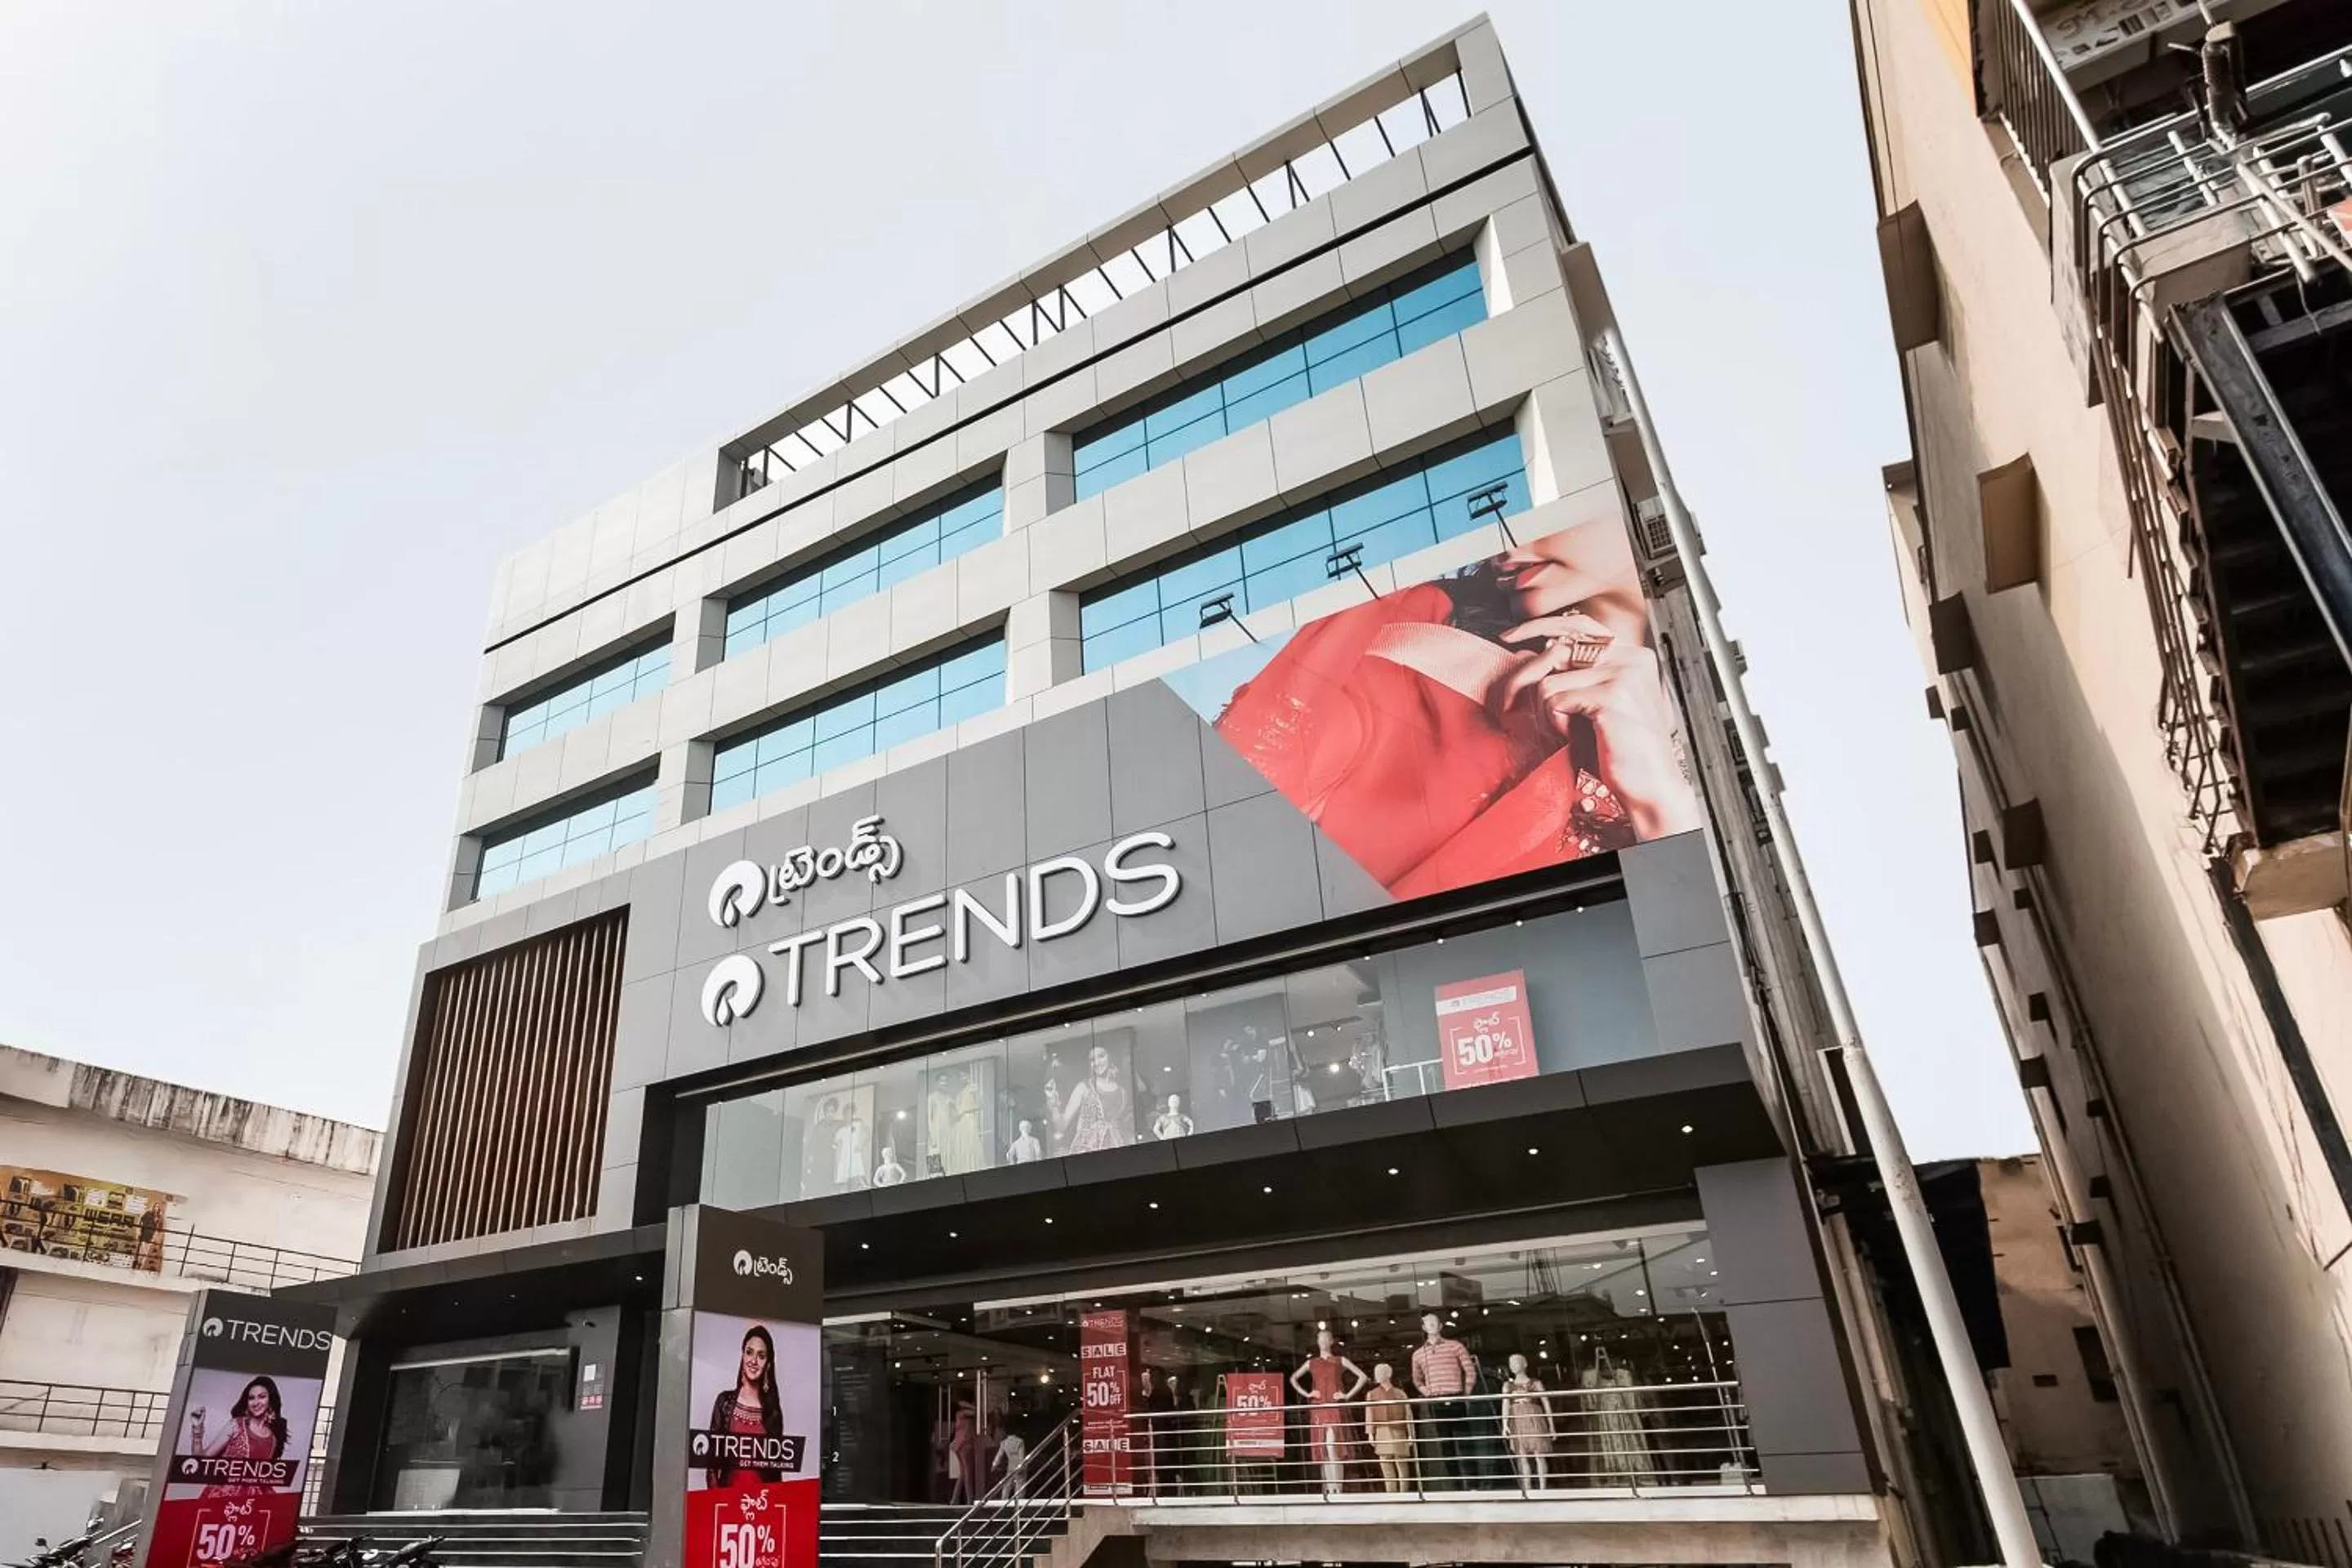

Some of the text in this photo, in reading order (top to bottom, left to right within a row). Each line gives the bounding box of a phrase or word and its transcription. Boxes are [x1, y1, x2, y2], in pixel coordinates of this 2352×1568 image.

[768, 814, 902, 905] ట్రెండ్స్
[768, 832, 1181, 1006] TRENDS
[1458, 1031, 1512, 1066] 50%
[754, 1256, 793, 1285] ట్రెండ్స్
[227, 1319, 333, 1350] TRENDS
[1082, 1344, 1126, 1357] SALE
[1093, 1365, 1116, 1379] FLAT
[1086, 1381, 1120, 1406] 50%
[1236, 1395, 1272, 1416] 50%
[710, 1434, 795, 1461] TRENDS
[831, 1450, 840, 1463] 2
[201, 1459, 287, 1479] TRENDS
[224, 1499, 255, 1522] ఫ్లాట్
[740, 1489, 769, 1521] ఫ్లాట్
[196, 1524, 256, 1561] 50%
[719, 1523, 776, 1568] 50%
